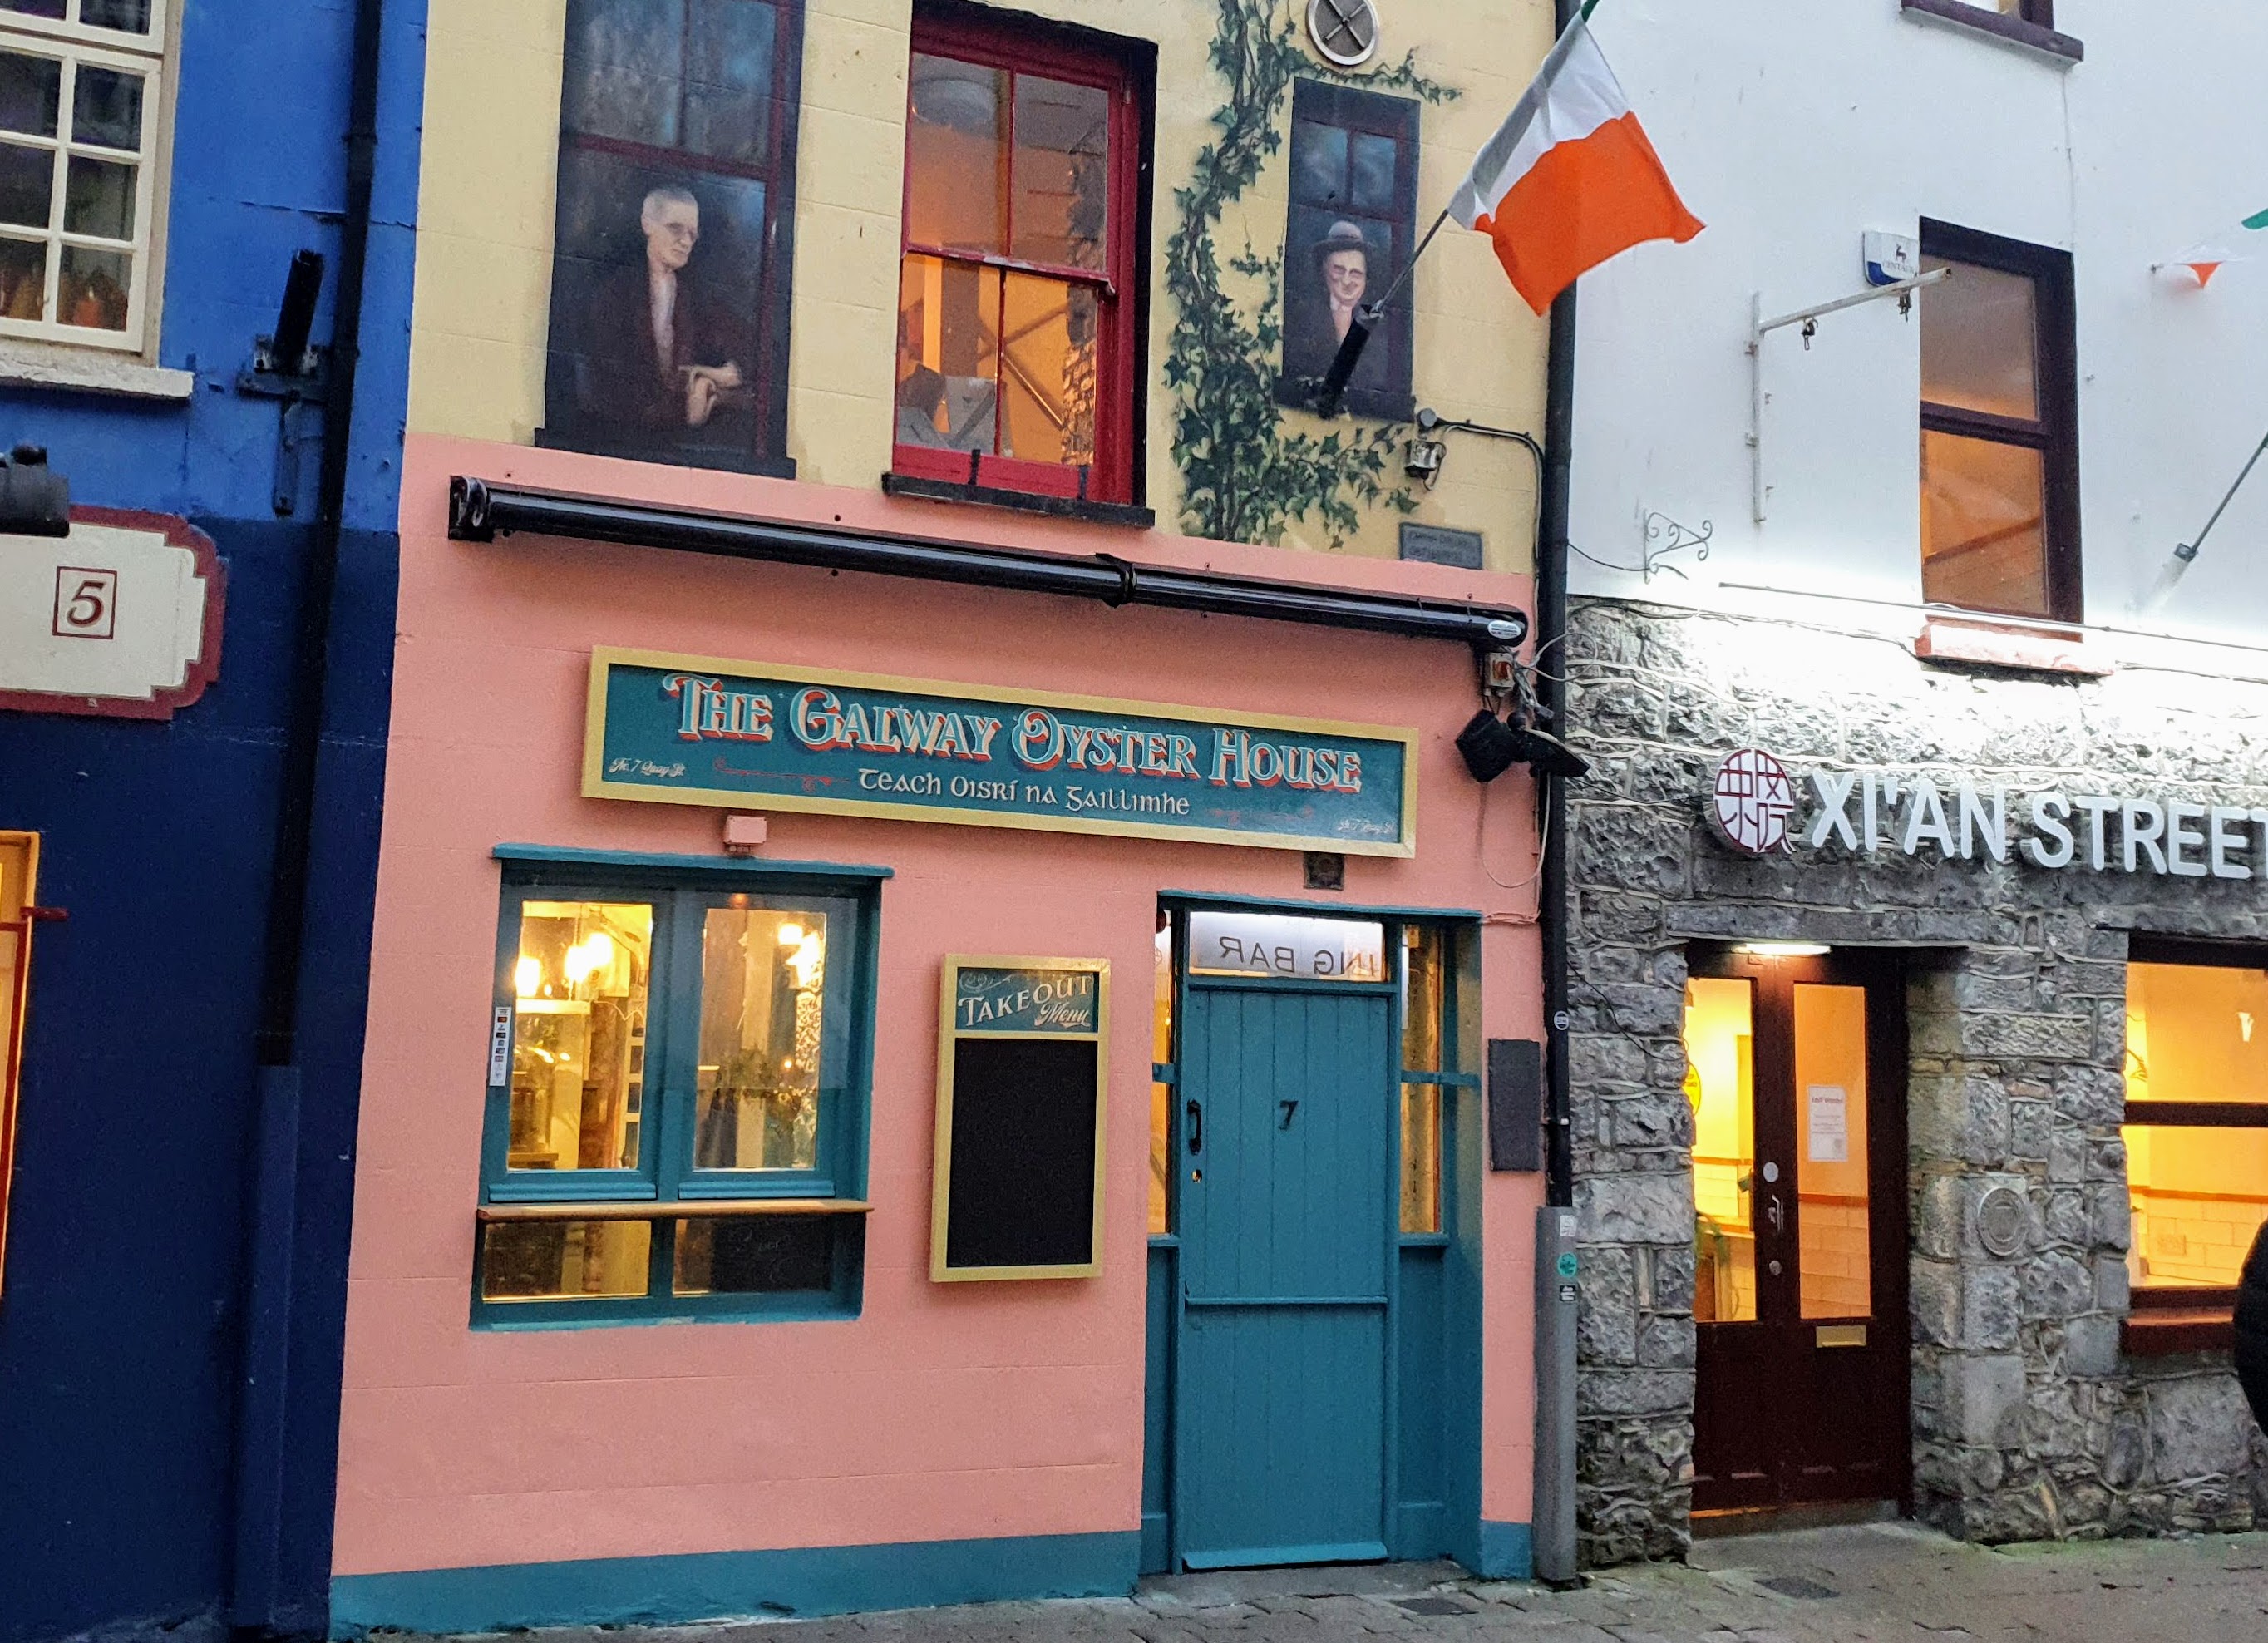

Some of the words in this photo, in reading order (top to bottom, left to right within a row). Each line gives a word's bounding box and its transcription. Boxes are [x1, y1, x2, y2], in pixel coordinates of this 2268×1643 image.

[66, 579, 105, 627] 5
[662, 672, 773, 741] THE
[789, 686, 1003, 762] GALWAY
[1011, 707, 1201, 780] OYSTER
[1208, 727, 1363, 793] HOUSE
[1024, 784, 1058, 805] na
[1811, 767, 2007, 861] XI'AN
[1033, 1000, 1092, 1029] Menu
[1278, 1099, 1299, 1131] 7
